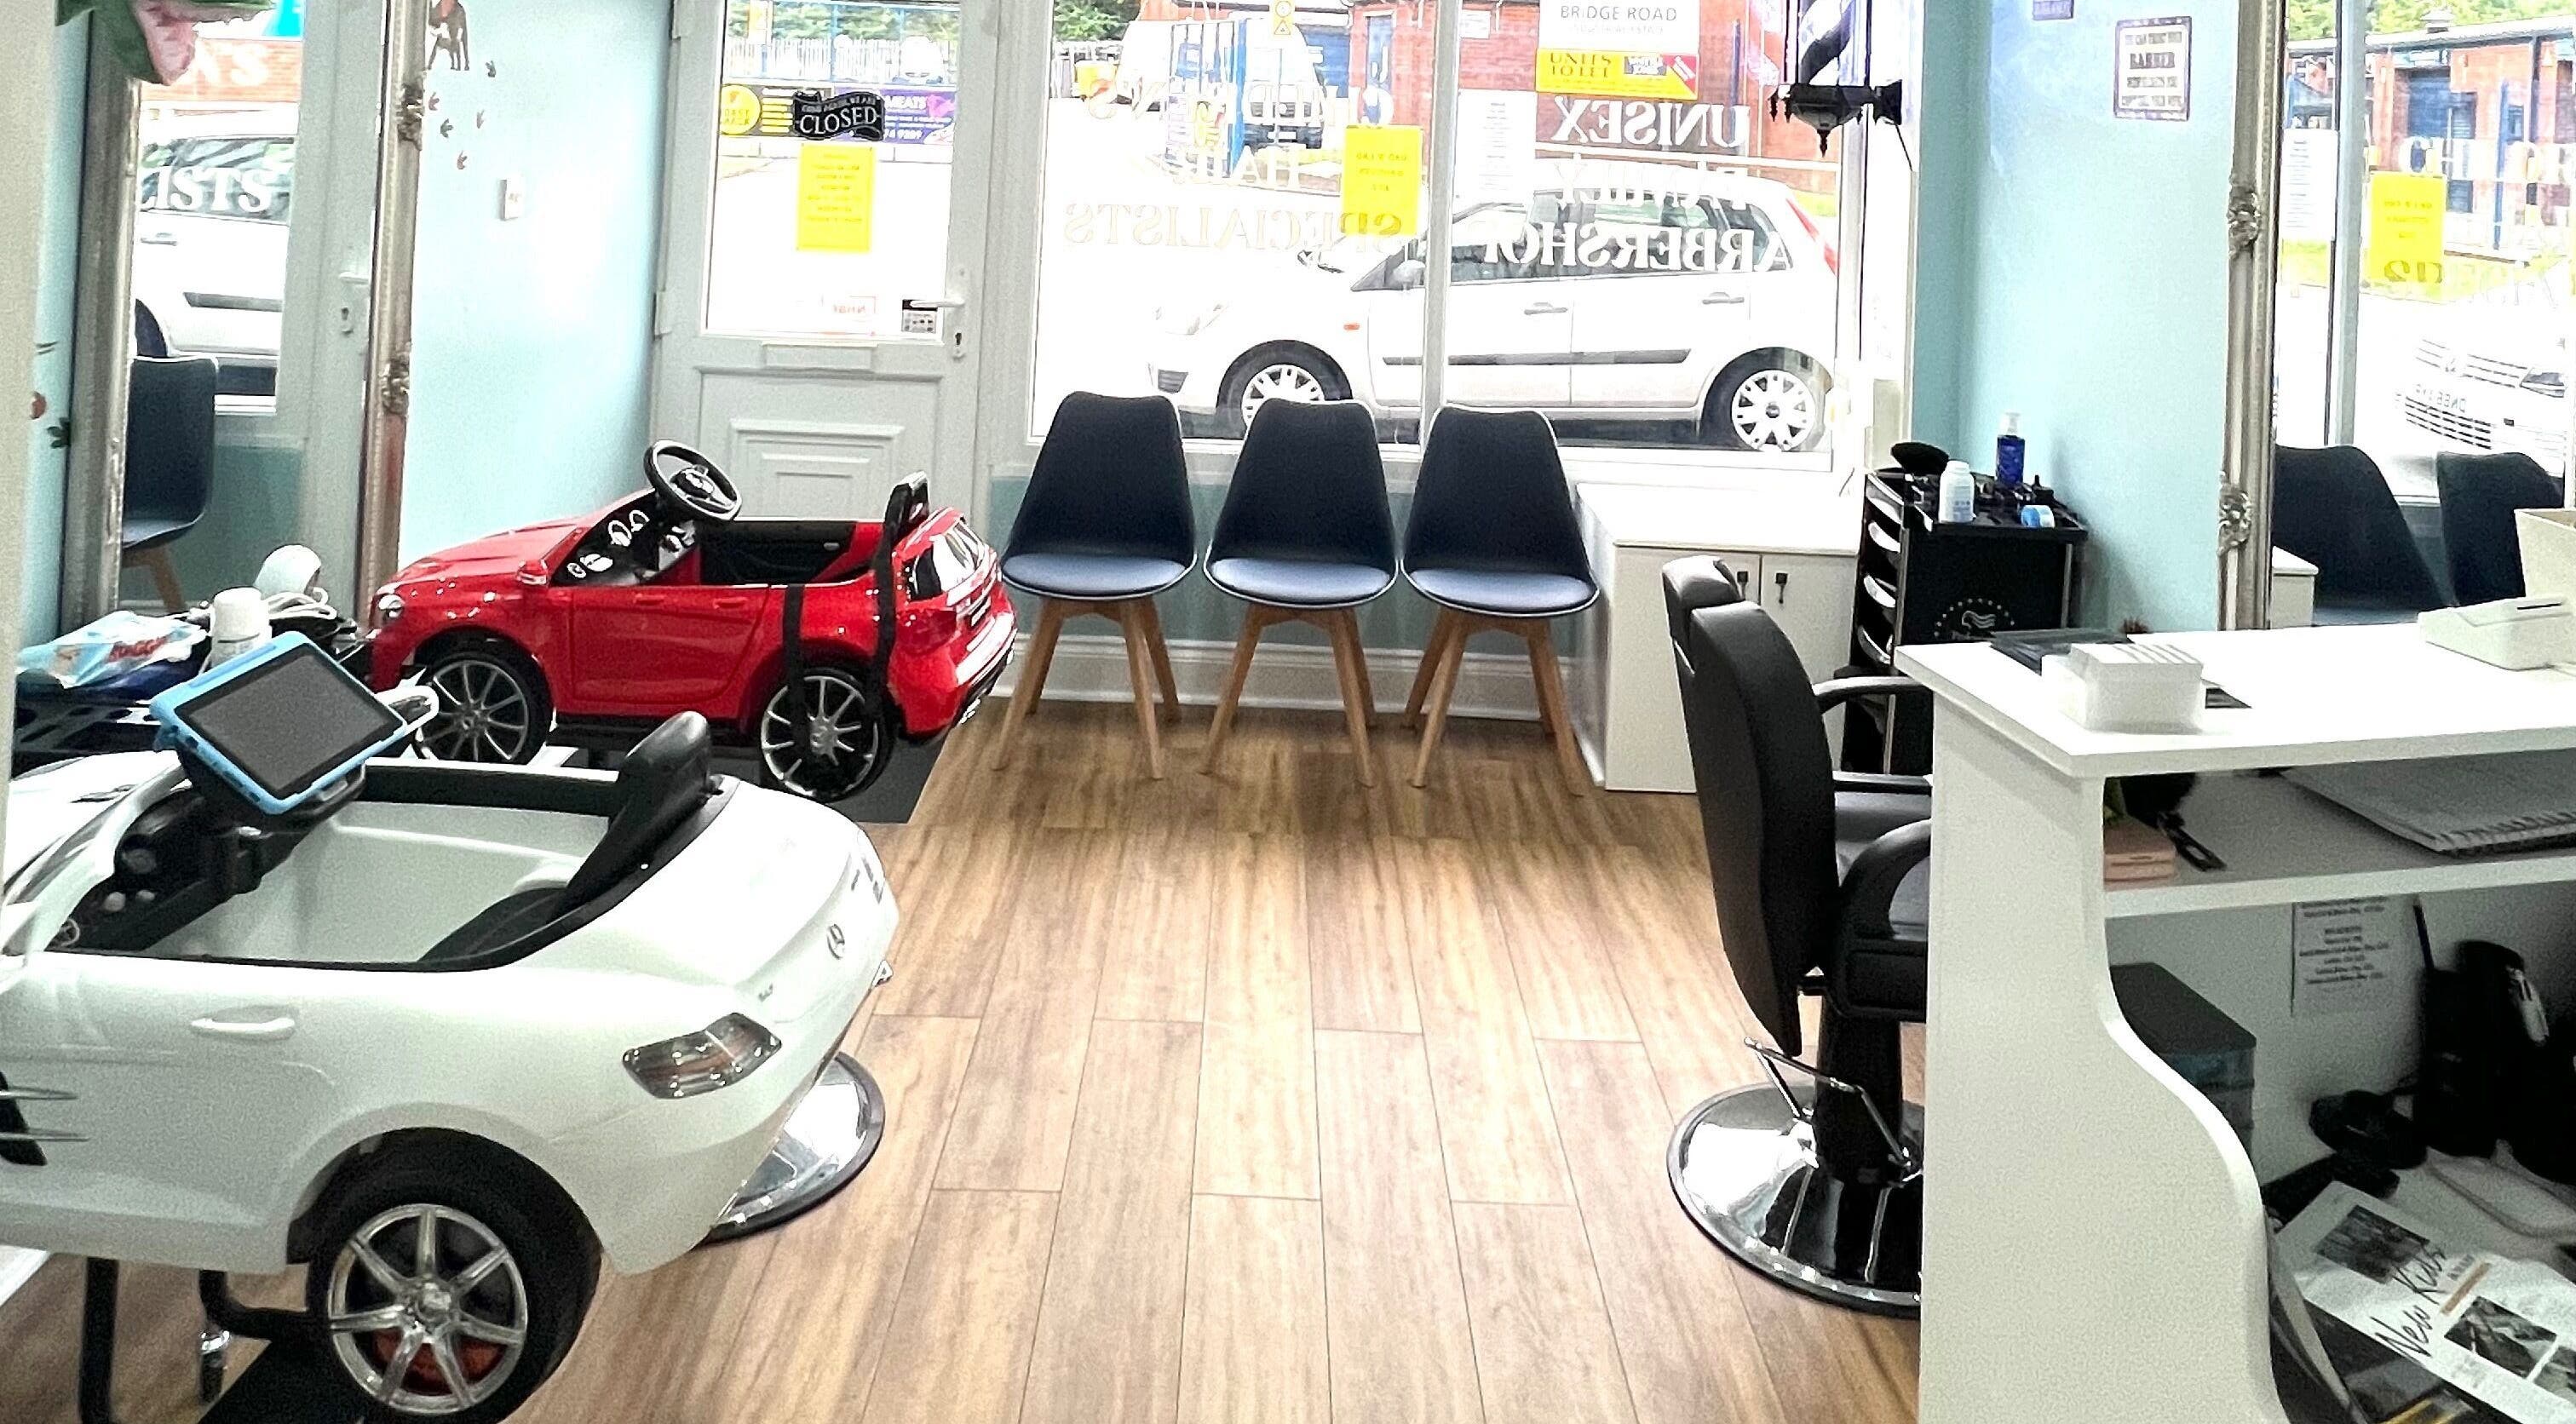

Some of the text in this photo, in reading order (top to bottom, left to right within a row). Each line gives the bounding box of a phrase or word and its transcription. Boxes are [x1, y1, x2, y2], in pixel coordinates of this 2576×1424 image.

[1561, 5, 1678, 22] BRIDGE ROAD
[1550, 52, 1613, 66] UNITS
[799, 106, 877, 135] CLOSED
[2370, 1304, 2433, 1364] New
